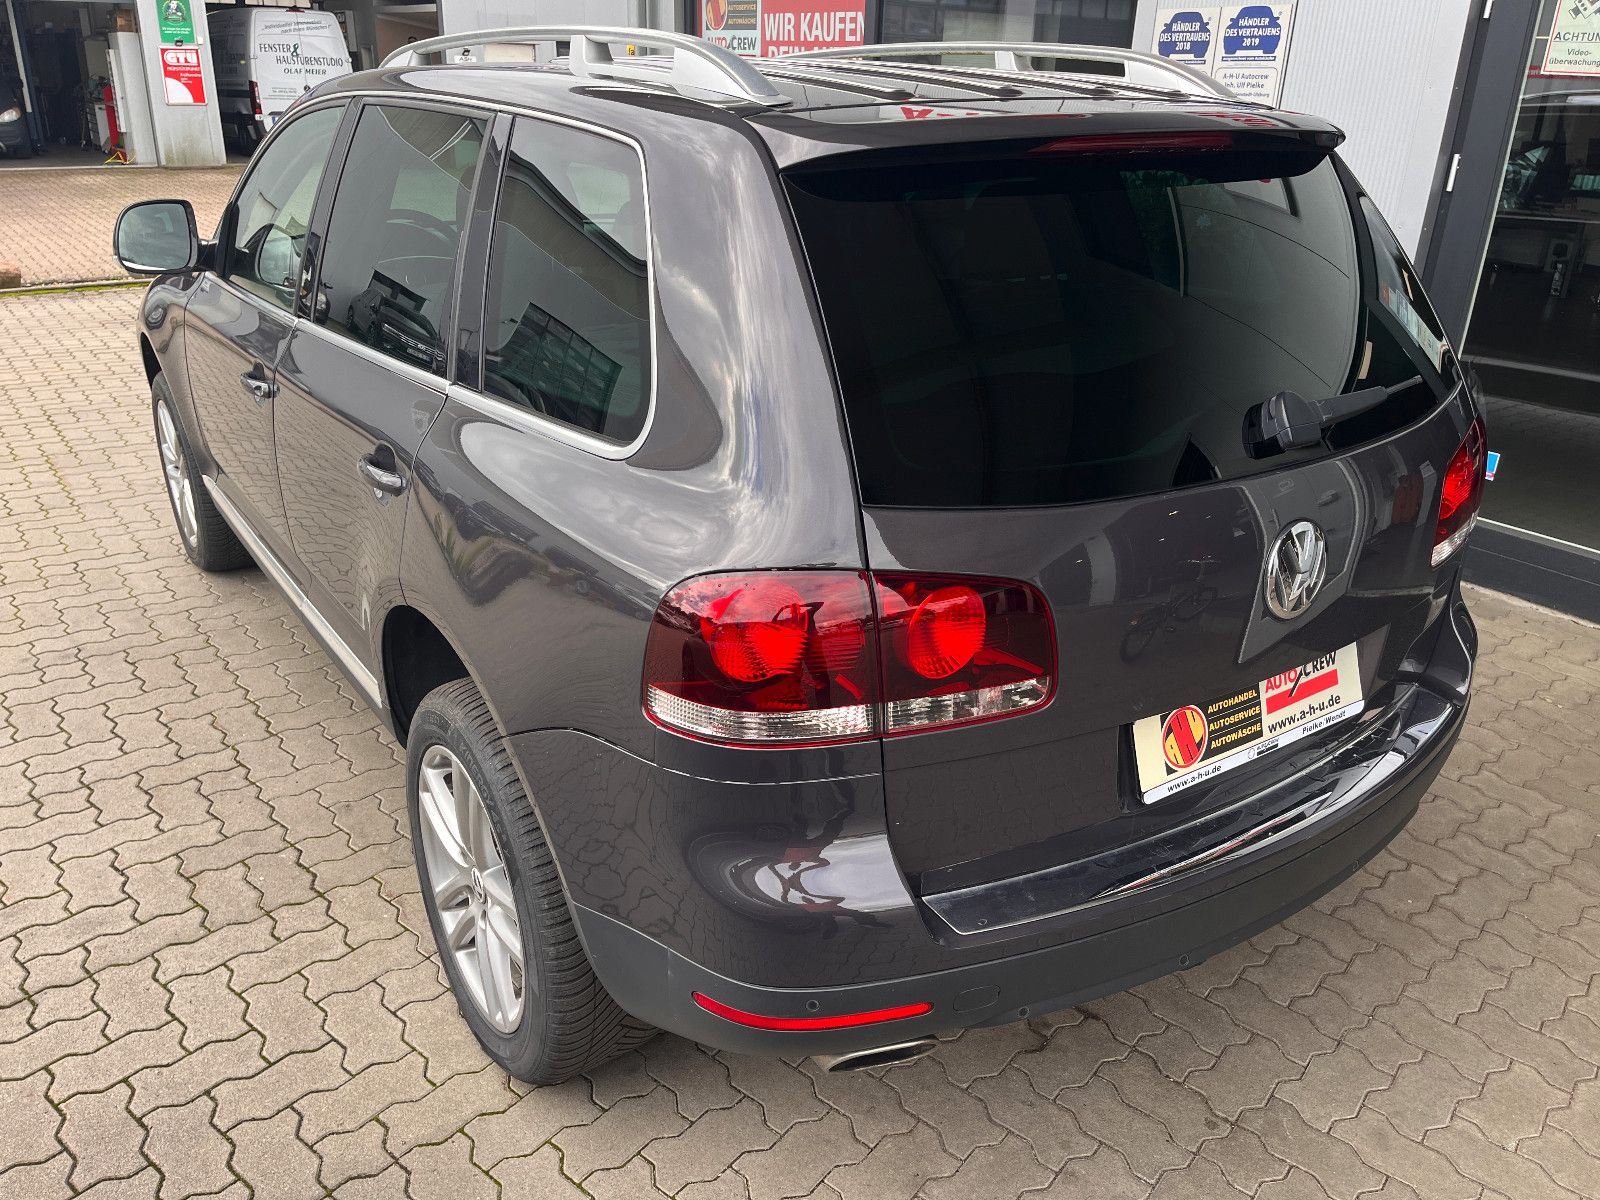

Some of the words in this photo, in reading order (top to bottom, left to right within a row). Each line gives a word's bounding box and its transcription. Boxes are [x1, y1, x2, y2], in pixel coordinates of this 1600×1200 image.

[764, 13, 795, 41] WIR
[801, 11, 865, 42] KAUFEN
[1172, 21, 1200, 31] HÄNDLER
[1239, 17, 1269, 26] HÄNDLER
[1160, 32, 1172, 42] DES
[1172, 32, 1211, 42] VERTRAUENS
[1225, 28, 1239, 37] DES
[1239, 27, 1281, 36] VERTRAUENS
[1175, 42, 1191, 51] 2018
[1242, 38, 1260, 46] 2019
[259, 43, 291, 53] FENSTER
[291, 43, 300, 57] &
[1567, 48, 1592, 57] Video-
[284, 67, 303, 75] OLAF
[305, 68, 327, 76] MEIER
[1265, 668, 1298, 693] AUTO
[1301, 651, 1337, 678] CREW
[1207, 689, 1257, 714] AUTOHANDEL
[1209, 705, 1261, 732] AUTOSERVICE
[1268, 694, 1341, 734] www.a-h-u.de
[1210, 723, 1262, 750] AUTOWÄSCHE
[1167, 764, 1222, 793] www.a-h-u.de
